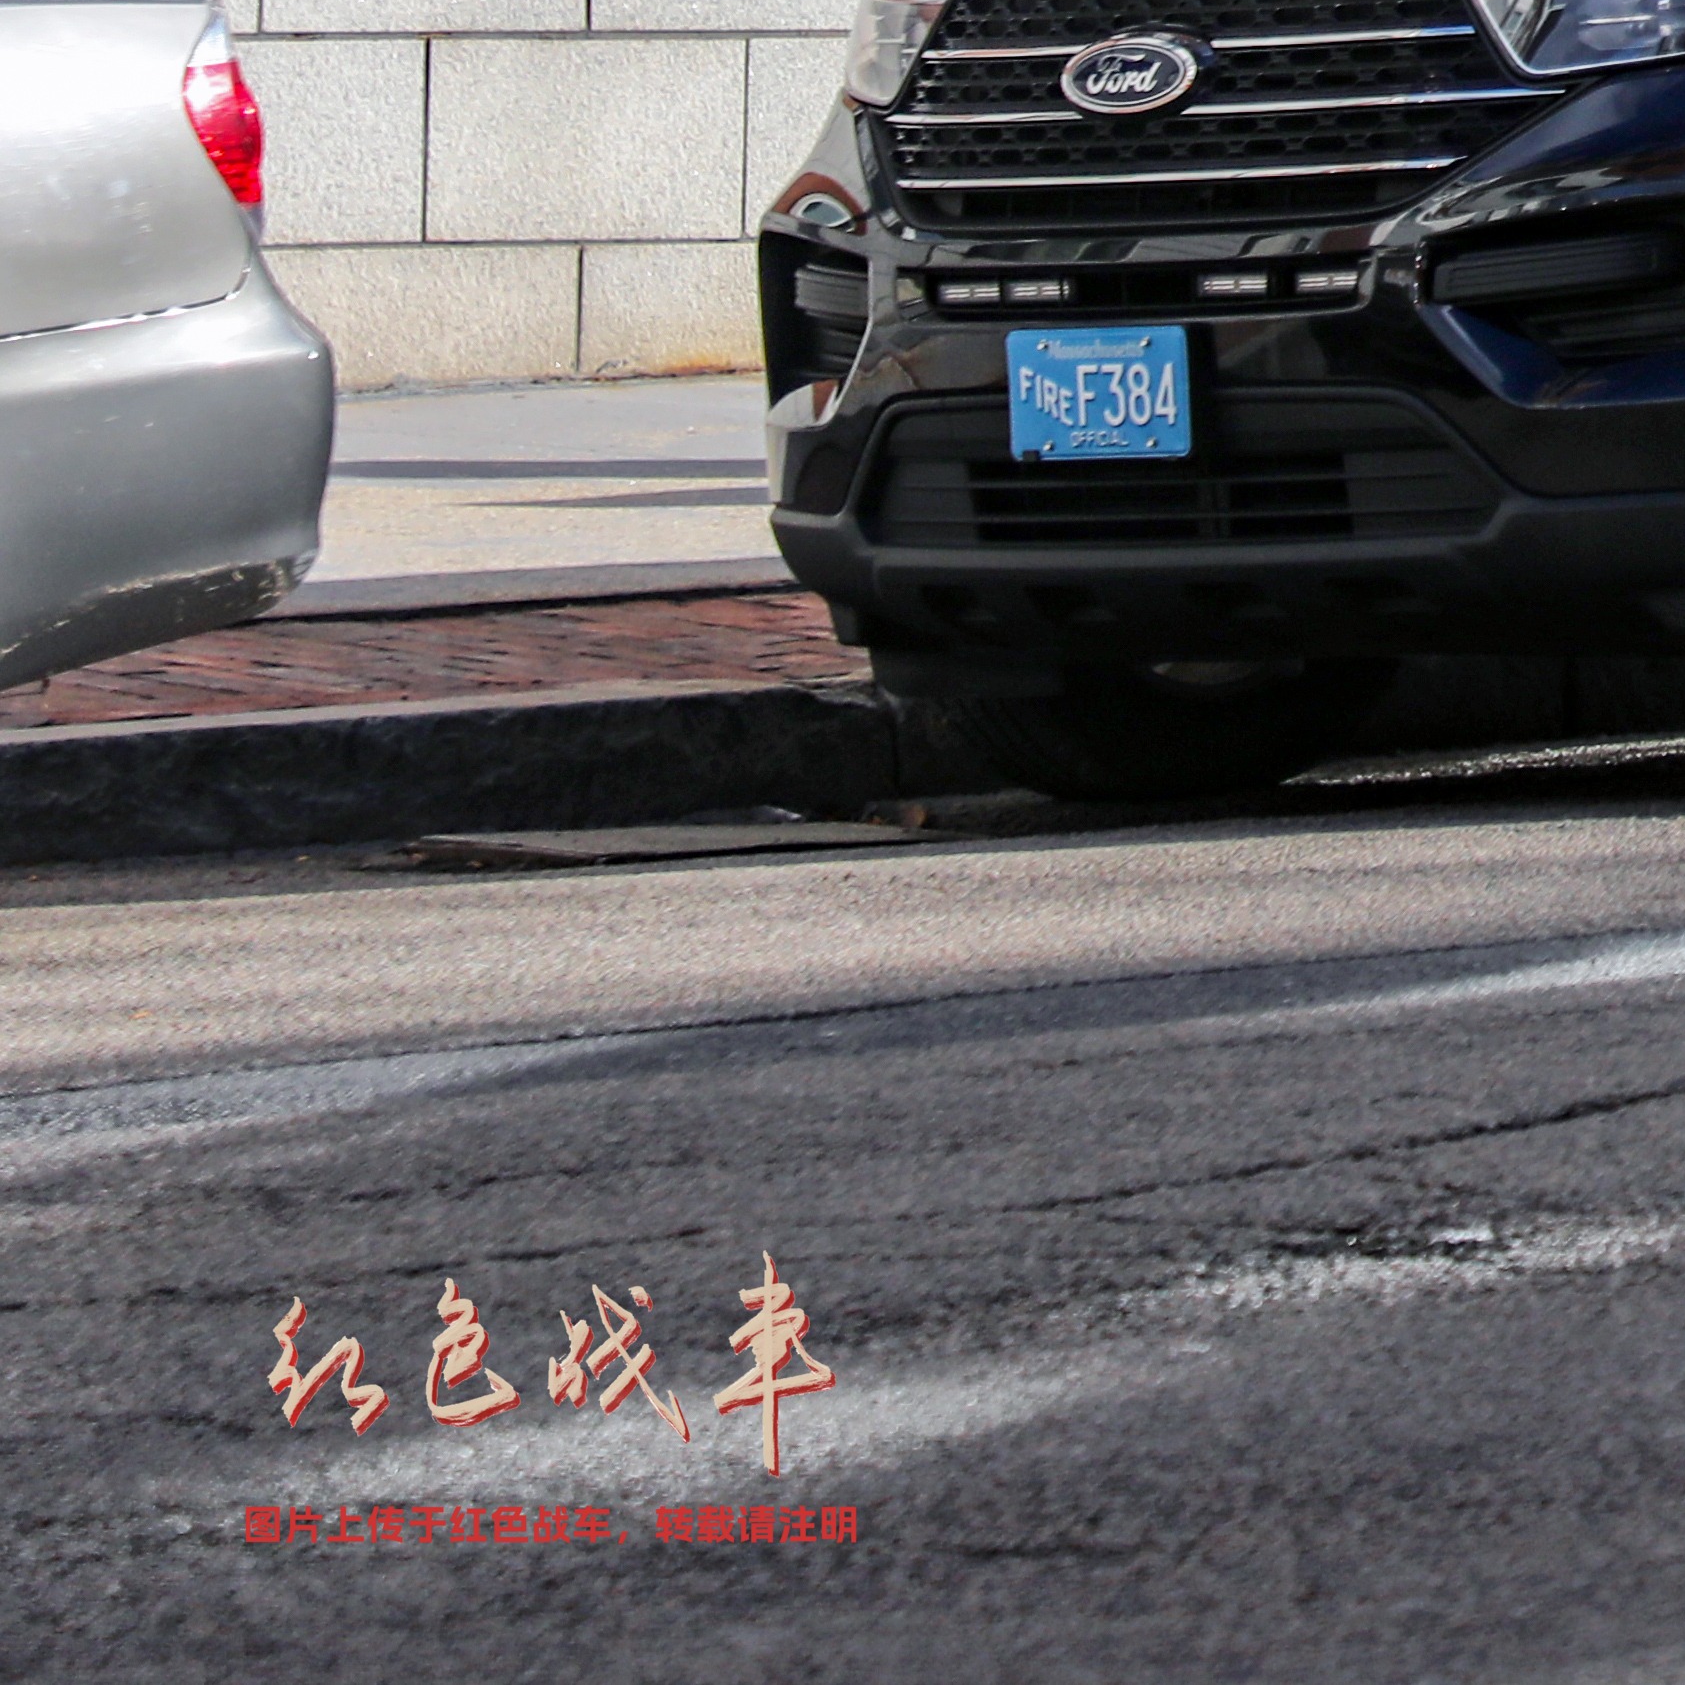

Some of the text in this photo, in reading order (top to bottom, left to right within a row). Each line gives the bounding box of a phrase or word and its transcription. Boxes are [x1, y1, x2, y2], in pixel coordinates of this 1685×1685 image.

[1085, 53, 1162, 95] Ford
[1018, 362, 1179, 428] FIRE F384
[1070, 430, 1130, 448] OFFICIAL
